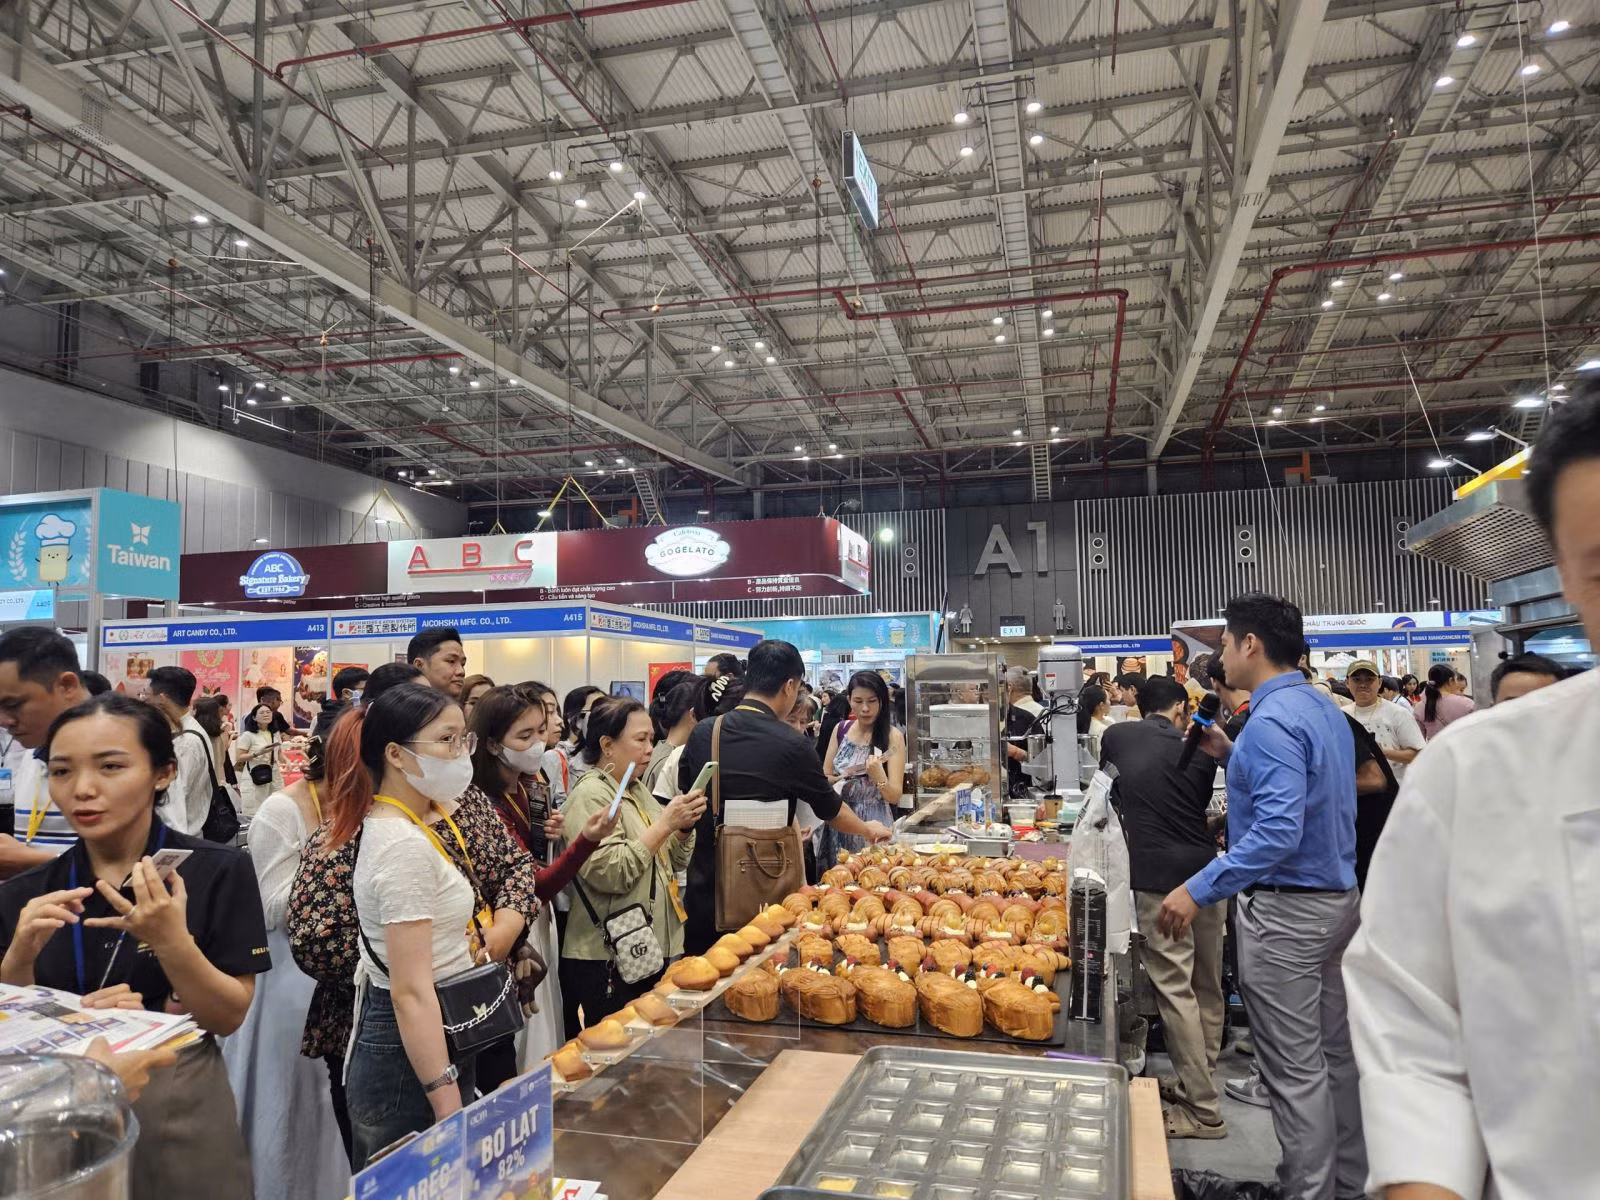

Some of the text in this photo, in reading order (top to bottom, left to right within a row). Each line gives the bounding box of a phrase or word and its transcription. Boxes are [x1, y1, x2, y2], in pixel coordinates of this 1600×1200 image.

[659, 546, 715, 558] GOGELATO
[974, 521, 1049, 577] A1
[107, 544, 172, 571] Taiwan
[263, 563, 284, 573] ABC
[239, 574, 309, 587] Signature Bakery
[421, 618, 459, 628] AICOHSHA
[460, 617, 478, 627] MFG.
[479, 617, 494, 627] CO.,
[495, 616, 512, 625] LTD.
[563, 613, 583, 622] A415
[173, 627, 238, 638] ART CANDY CO., LTD.
[307, 624, 325, 632] A413
[1003, 627, 1024, 635] EXIT
[481, 1103, 539, 1168] BƠ LẠT
[498, 1147, 526, 1180] 82%
